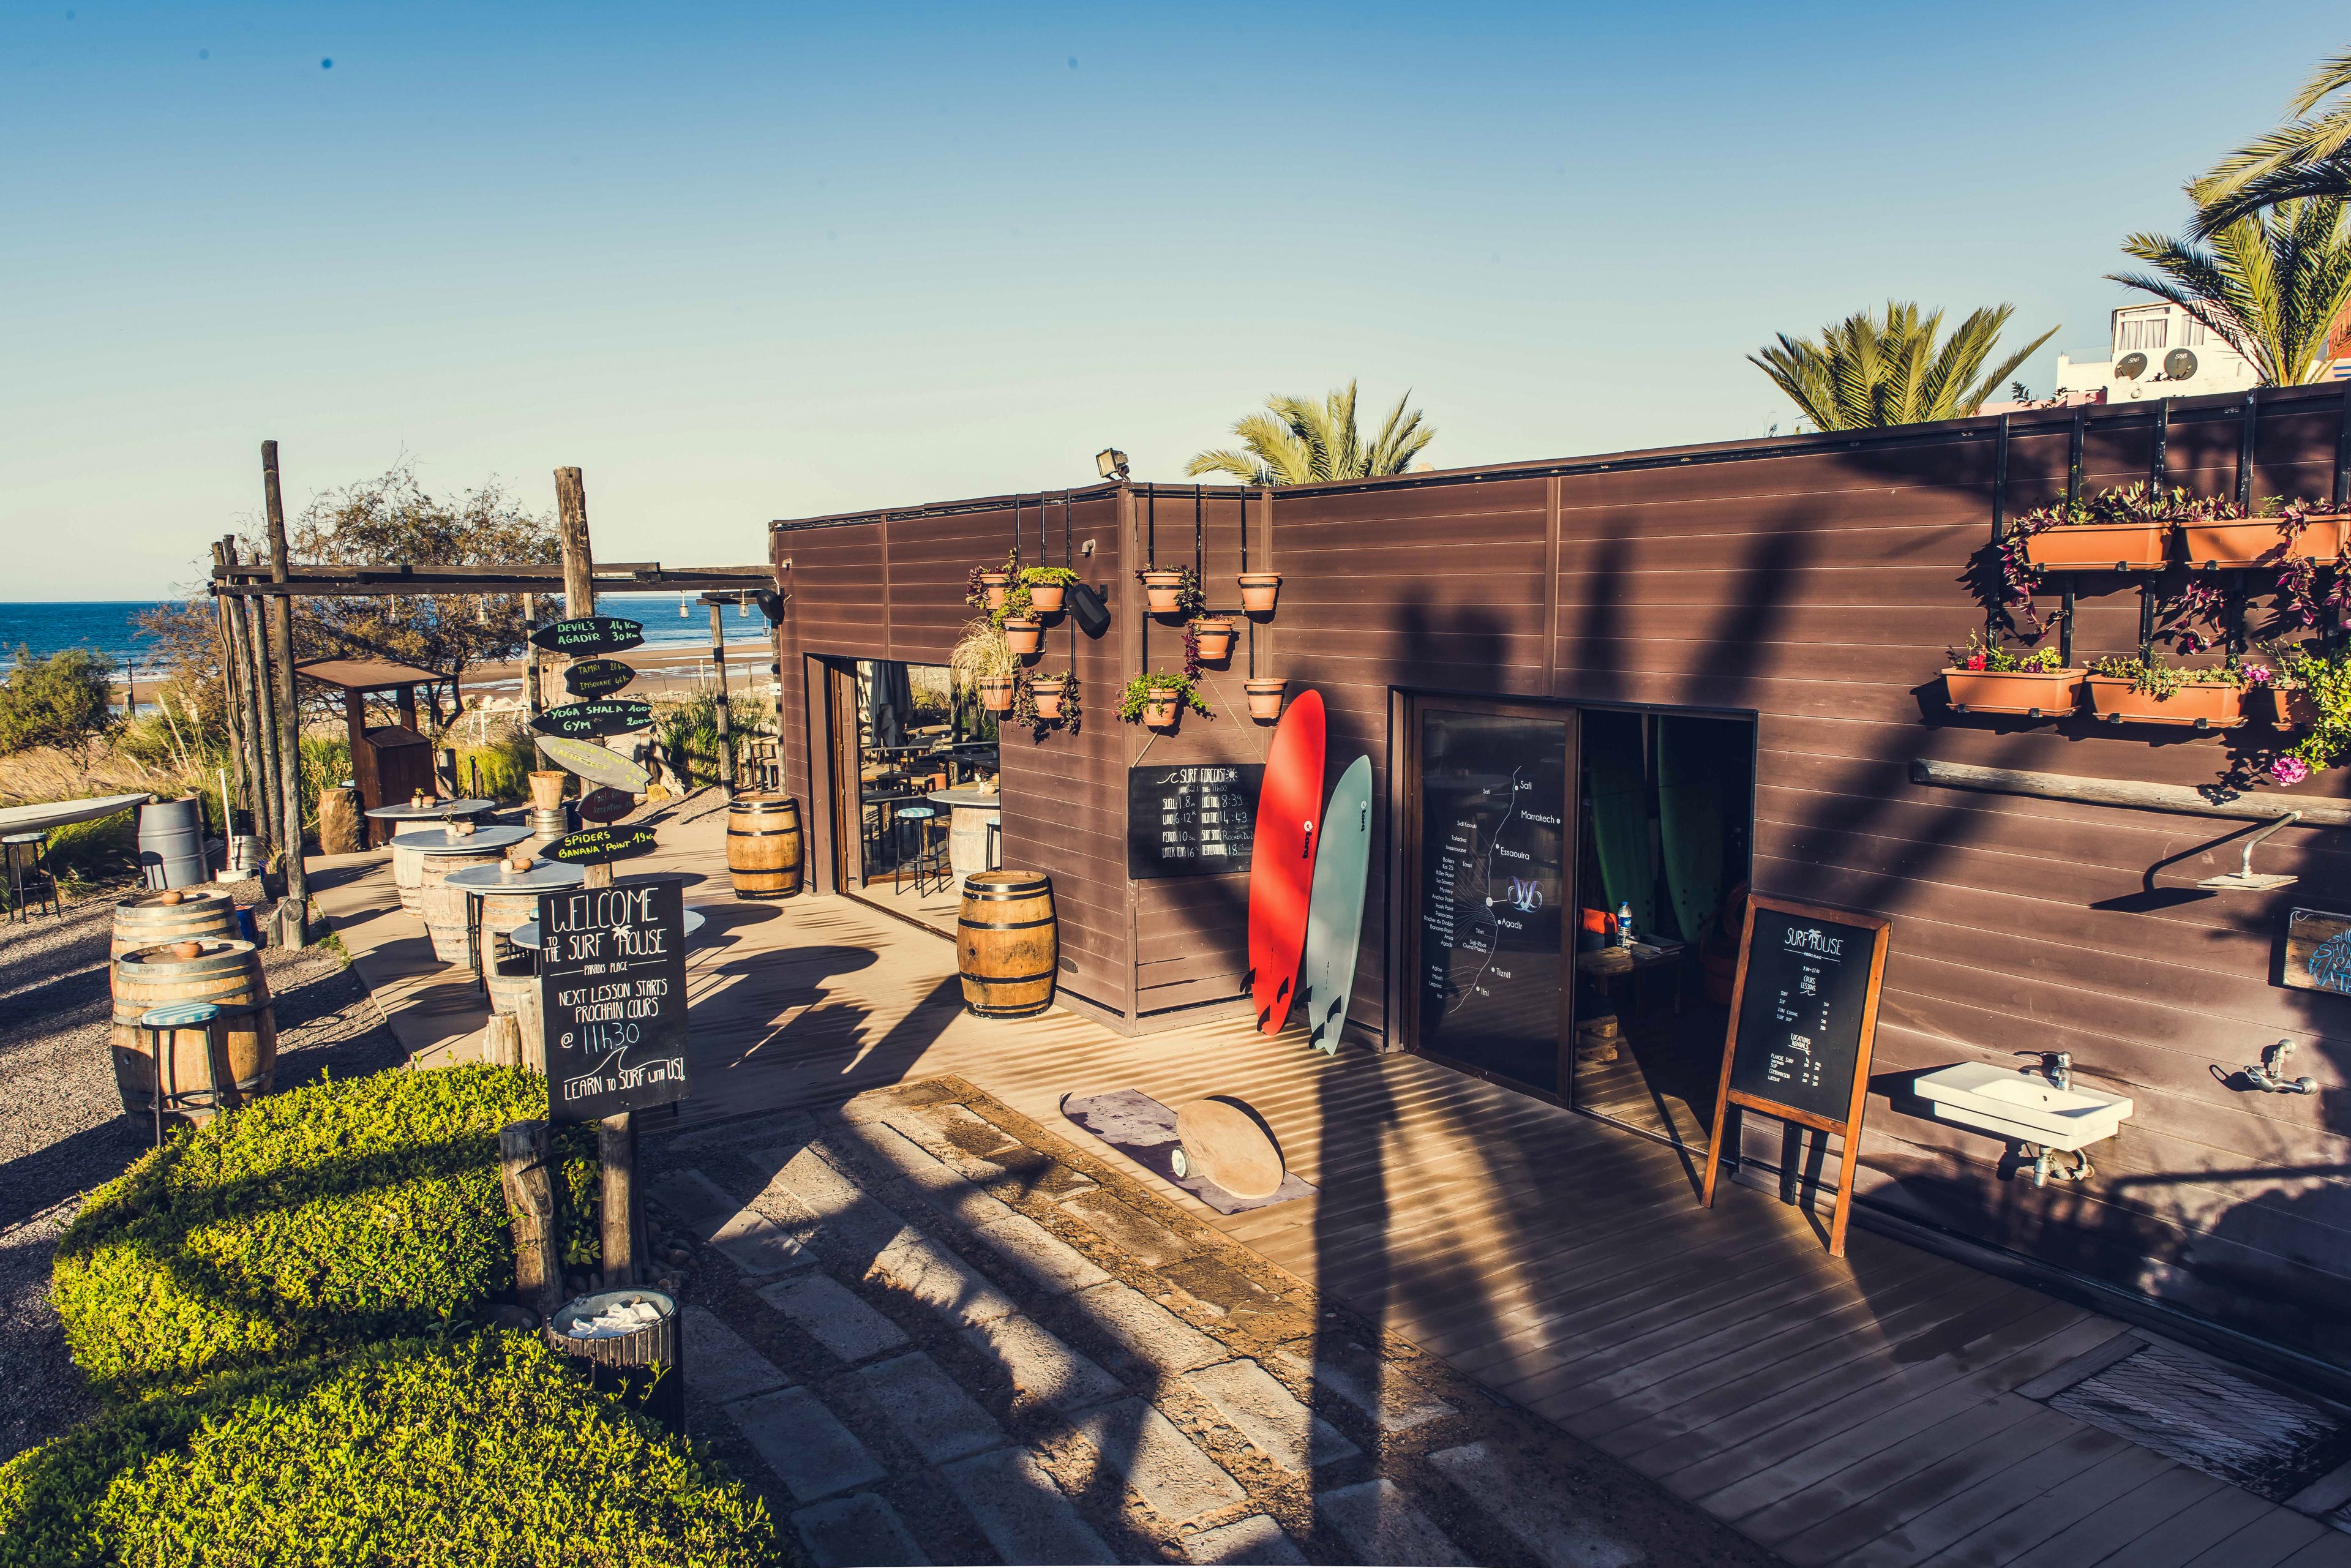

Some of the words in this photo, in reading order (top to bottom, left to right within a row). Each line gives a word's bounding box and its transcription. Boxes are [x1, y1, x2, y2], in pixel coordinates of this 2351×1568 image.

[609, 621, 622, 630] 14
[612, 632, 624, 641] 30
[580, 679, 612, 690] IMSOUANE
[551, 708, 580, 719] YOGA
[563, 721, 591, 731] GYM
[1180, 768, 1198, 783] SURF
[1201, 768, 1226, 782] FORECAST
[1520, 780, 1532, 790] Safi
[1221, 794, 1243, 808] 8:39
[1521, 810, 1554, 823] Marrakech
[558, 846, 600, 858] BANANA
[1501, 847, 1529, 860] Essaouira
[551, 887, 659, 932] WELCOME
[1501, 918, 1523, 929] Agadir
[542, 946, 561, 962] THE
[568, 932, 605, 960] SURF
[617, 928, 667, 956] HOUSE
[547, 936, 558, 947] TO
[1785, 928, 1809, 947] SURF
[1810, 934, 1844, 955] HOUSE
[584, 964, 606, 976] PARADIS
[610, 961, 628, 973] PLAGE
[1496, 967, 1511, 979] Tiznit
[1804, 975, 1815, 984] COURS
[558, 989, 587, 1007] NEXT
[591, 983, 630, 1003] LESSON
[636, 978, 667, 997] STARTS
[1481, 987, 1490, 997] Ifni
[1801, 982, 1816, 991] LESSONS
[576, 1001, 624, 1023] PROCHAIN
[628, 997, 659, 1018] COURS
[561, 1032, 574, 1049] @
[1790, 1033, 1811, 1045] LOCATIONS
[564, 1076, 602, 1100] LEARN
[618, 1068, 646, 1090] SURF
